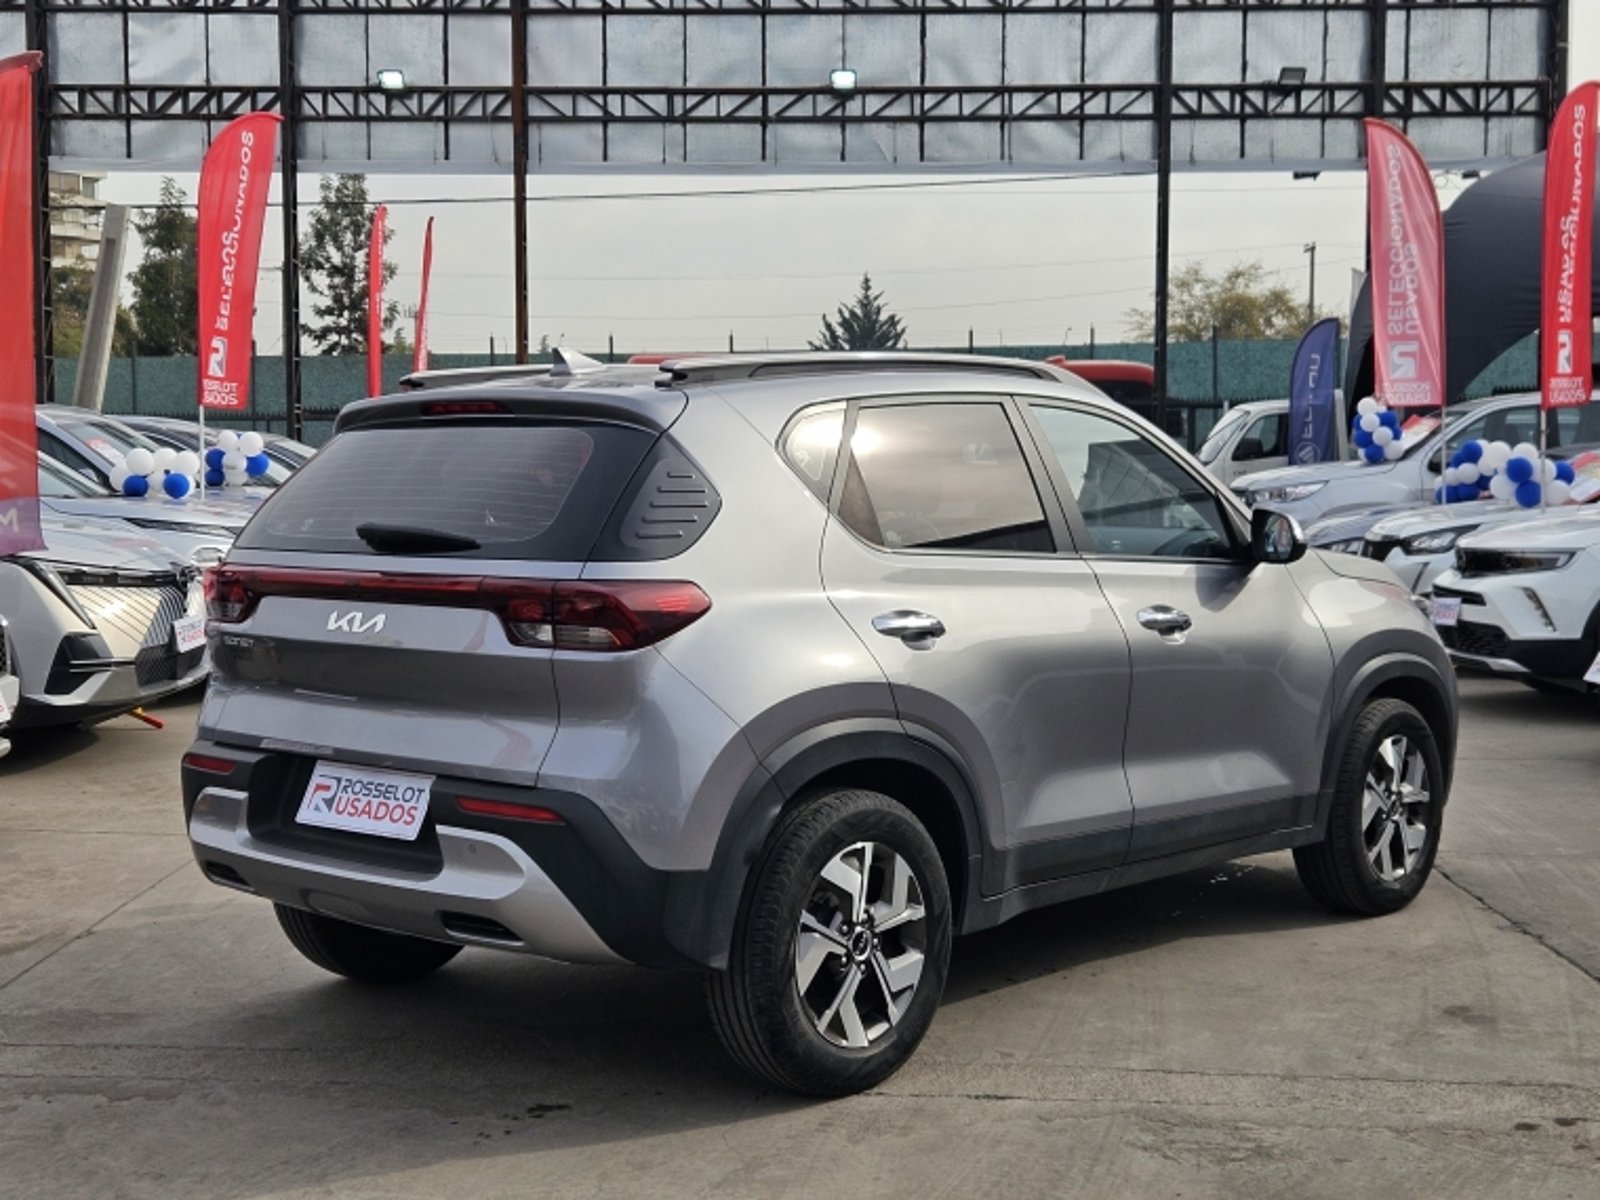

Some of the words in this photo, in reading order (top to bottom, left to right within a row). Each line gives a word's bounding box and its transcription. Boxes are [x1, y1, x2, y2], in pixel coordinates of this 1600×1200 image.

[327, 610, 386, 633] KIA
[340, 778, 426, 805] ROSSELOT
[334, 796, 418, 826] USADOS
